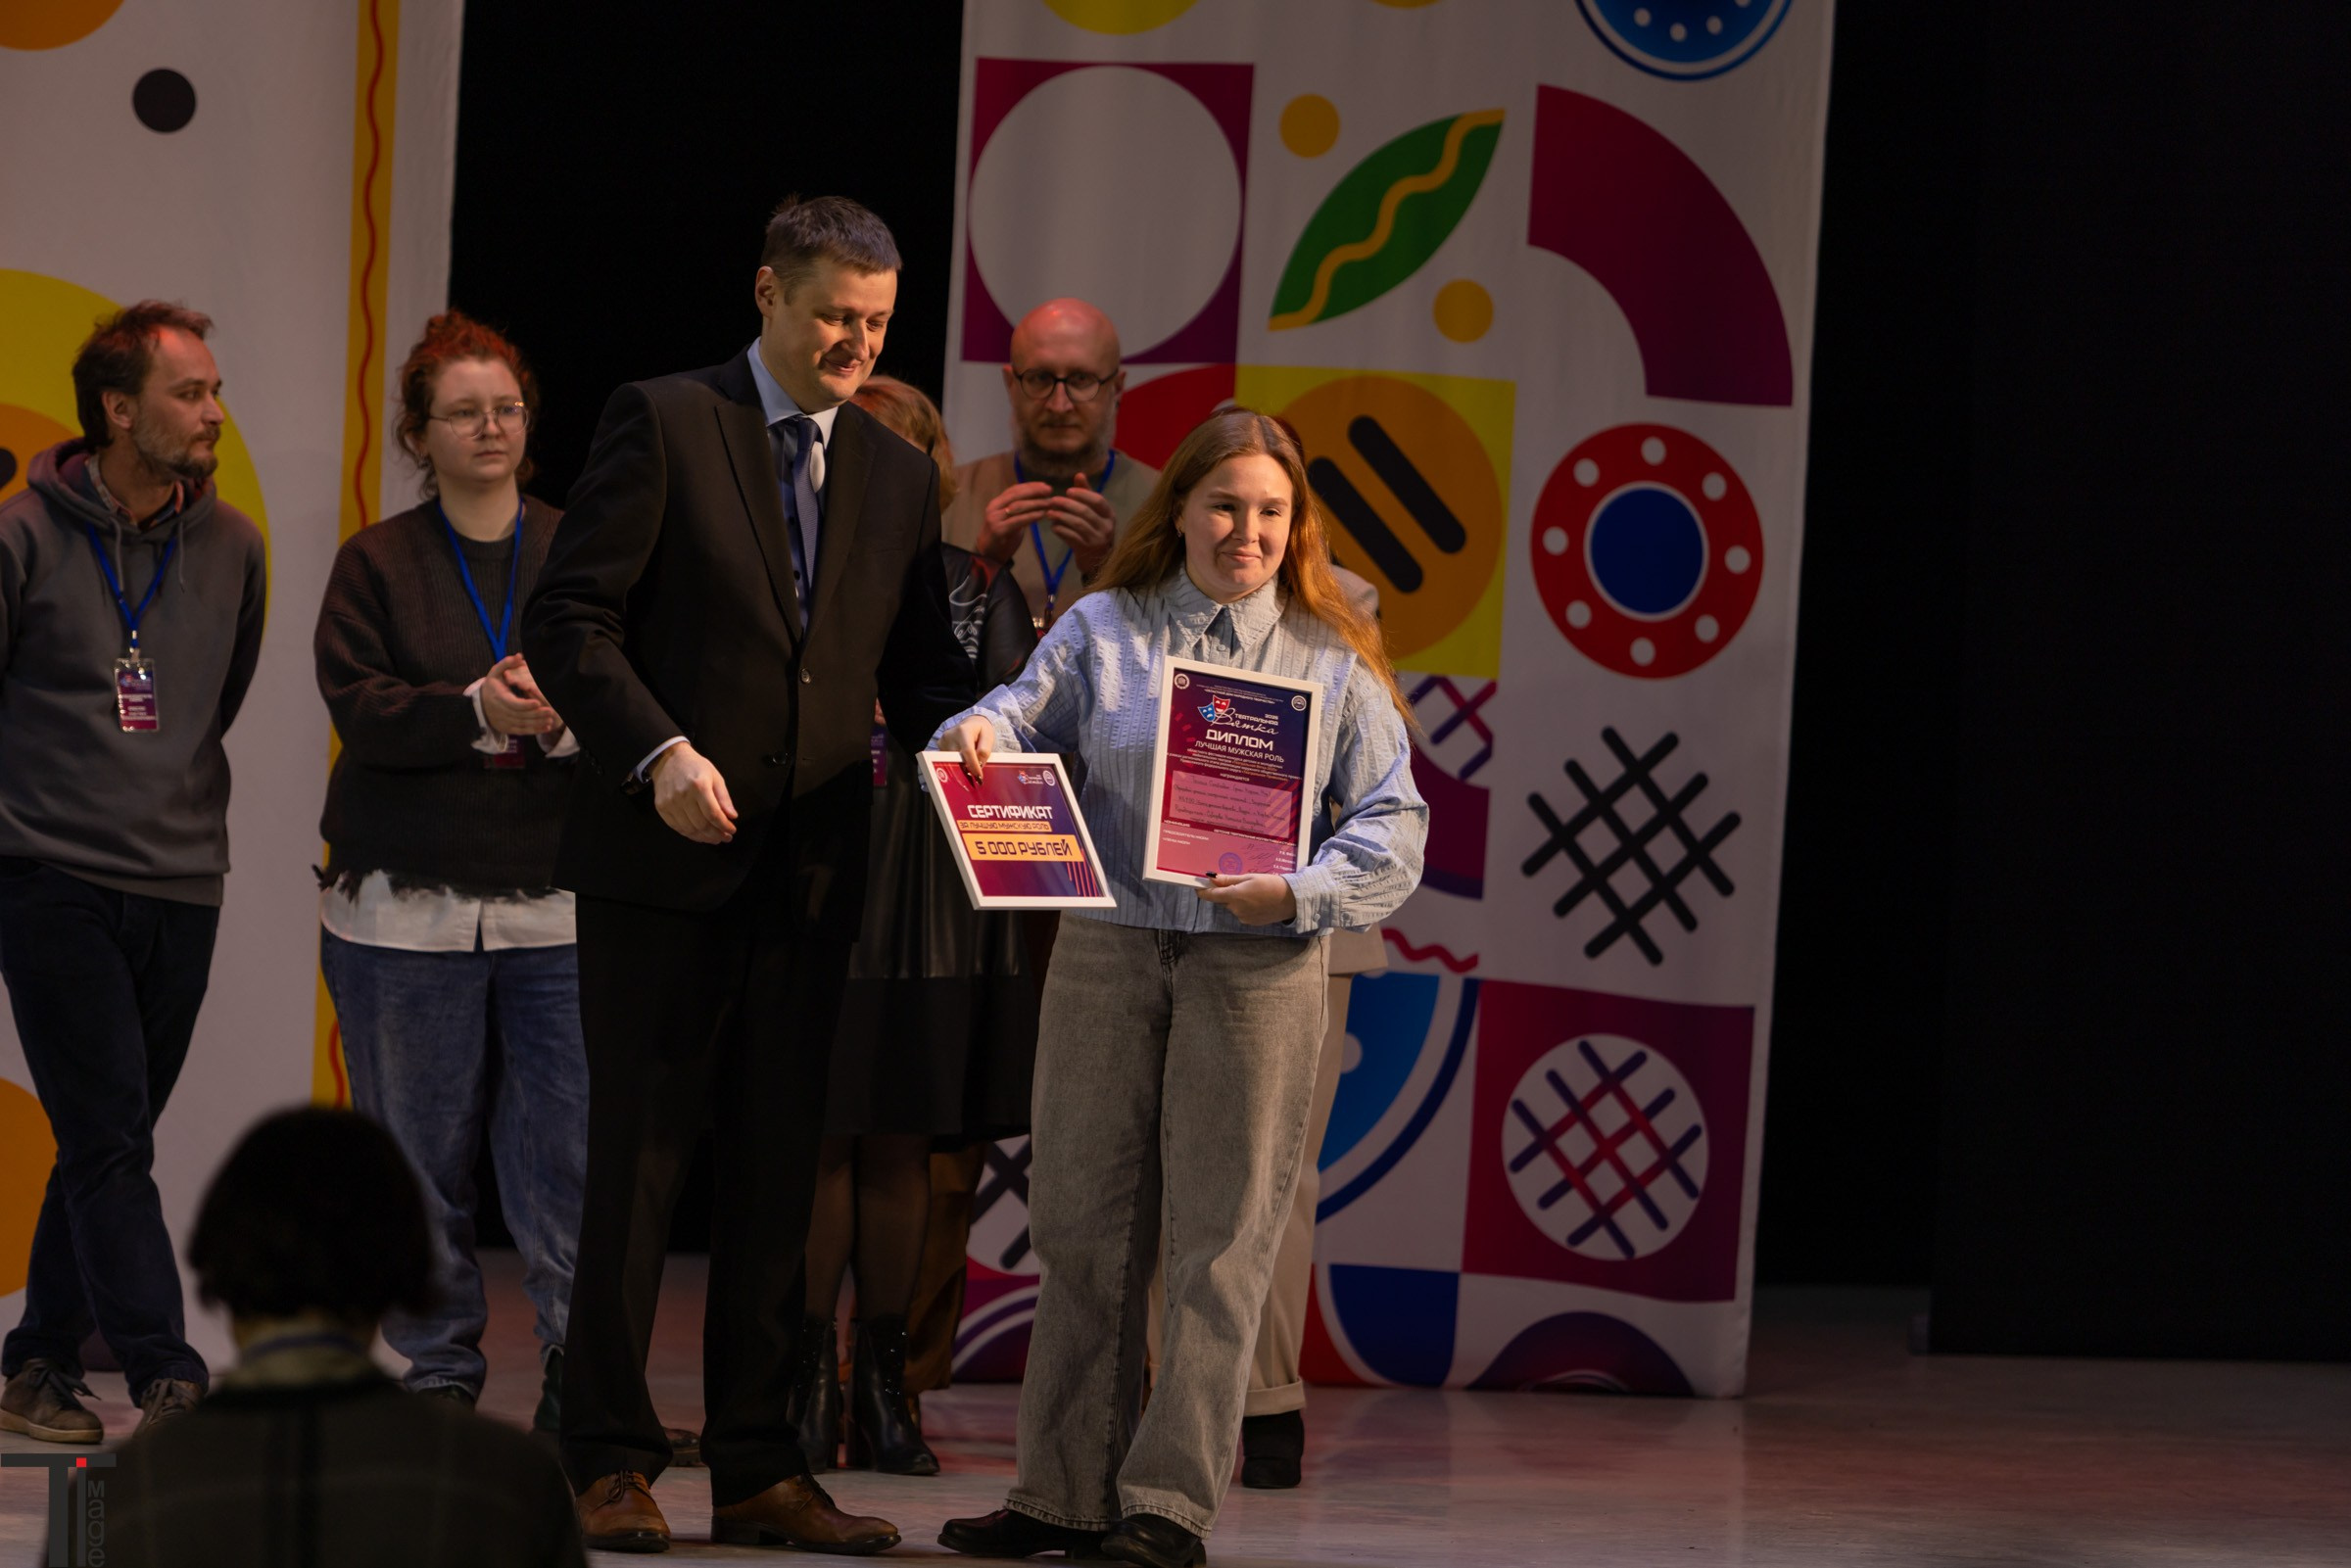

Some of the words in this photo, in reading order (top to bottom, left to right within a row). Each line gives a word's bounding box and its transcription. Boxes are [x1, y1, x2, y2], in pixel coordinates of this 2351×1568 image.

[1211, 708, 1279, 735] Вятка
[1235, 713, 1278, 726] ТЕАТРАЛЬНАЯ
[1205, 730, 1273, 751] ДИПЛОМ
[1195, 741, 1227, 752] ЛУЧШАЯ
[1228, 747, 1263, 759] МУЖСКАЯ
[1264, 754, 1284, 763] РОЛЬ
[967, 805, 1053, 819] СЕРТИФИКАТ
[975, 842, 986, 855] 5
[989, 842, 1016, 855] 000
[1018, 839, 1073, 856] РУБЛЕЙ
